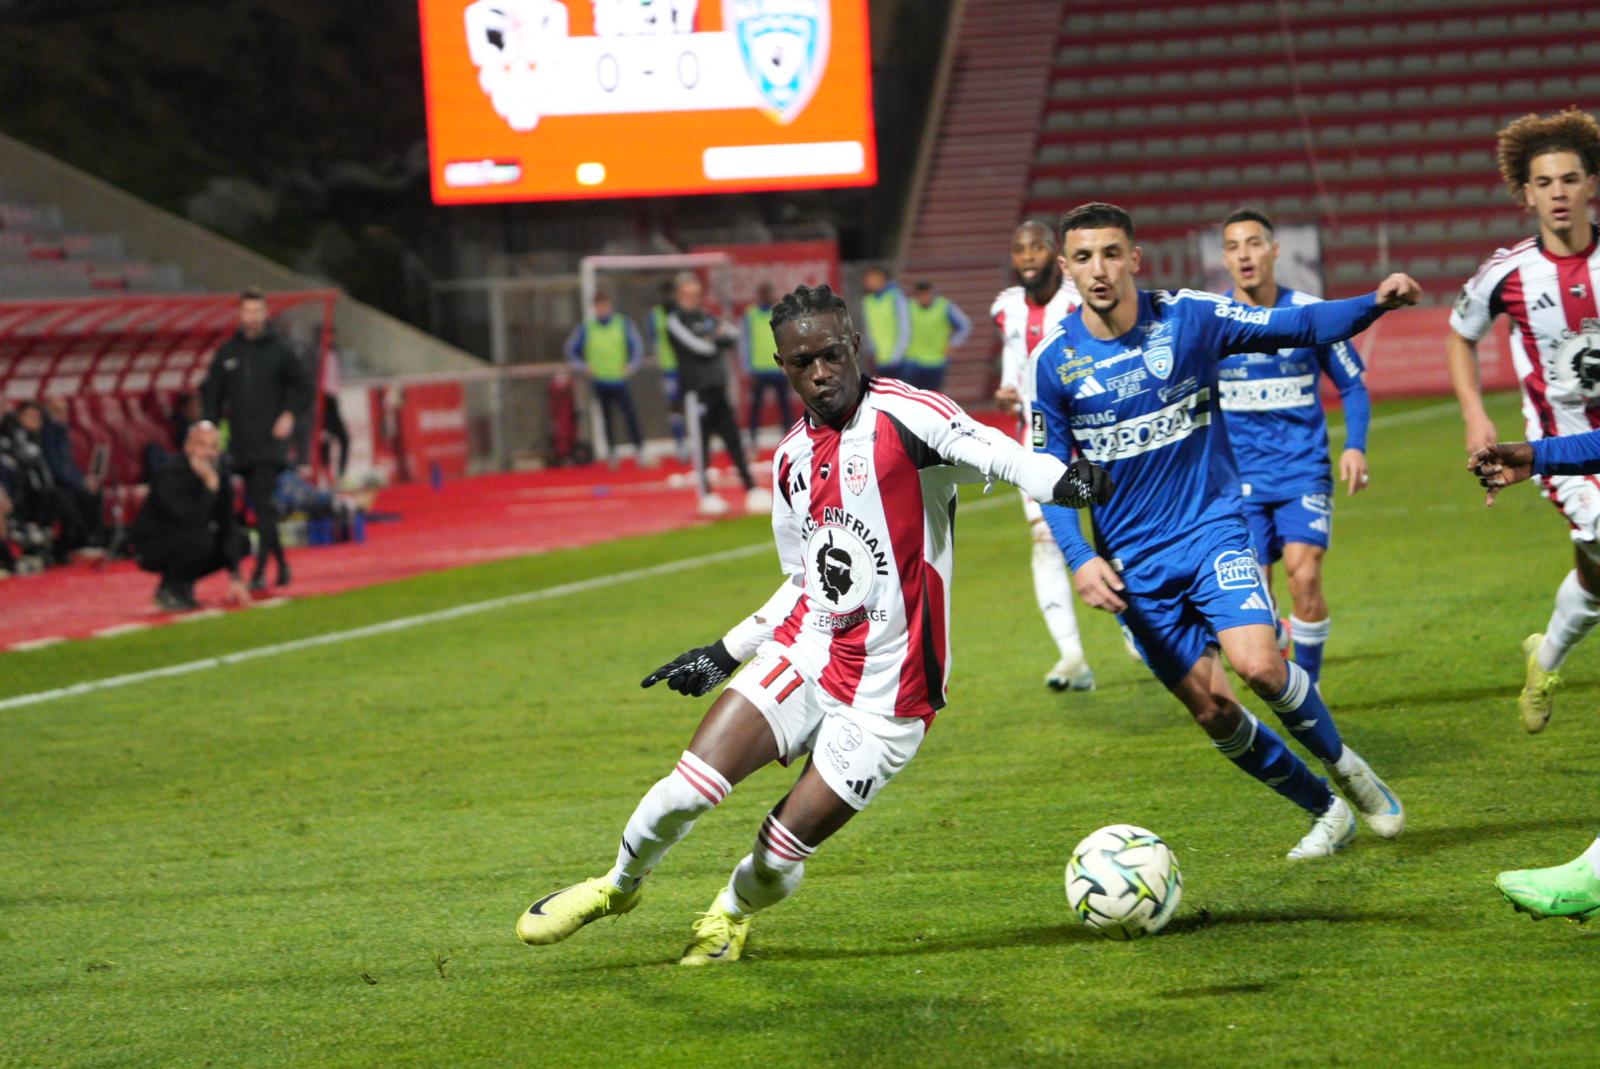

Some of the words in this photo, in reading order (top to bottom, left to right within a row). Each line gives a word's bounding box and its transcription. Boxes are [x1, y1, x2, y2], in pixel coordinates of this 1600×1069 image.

[1214, 302, 1272, 325] actual
[824, 507, 889, 576] ANFRIANI
[1220, 566, 1258, 581] KING
[759, 655, 804, 705] 11
